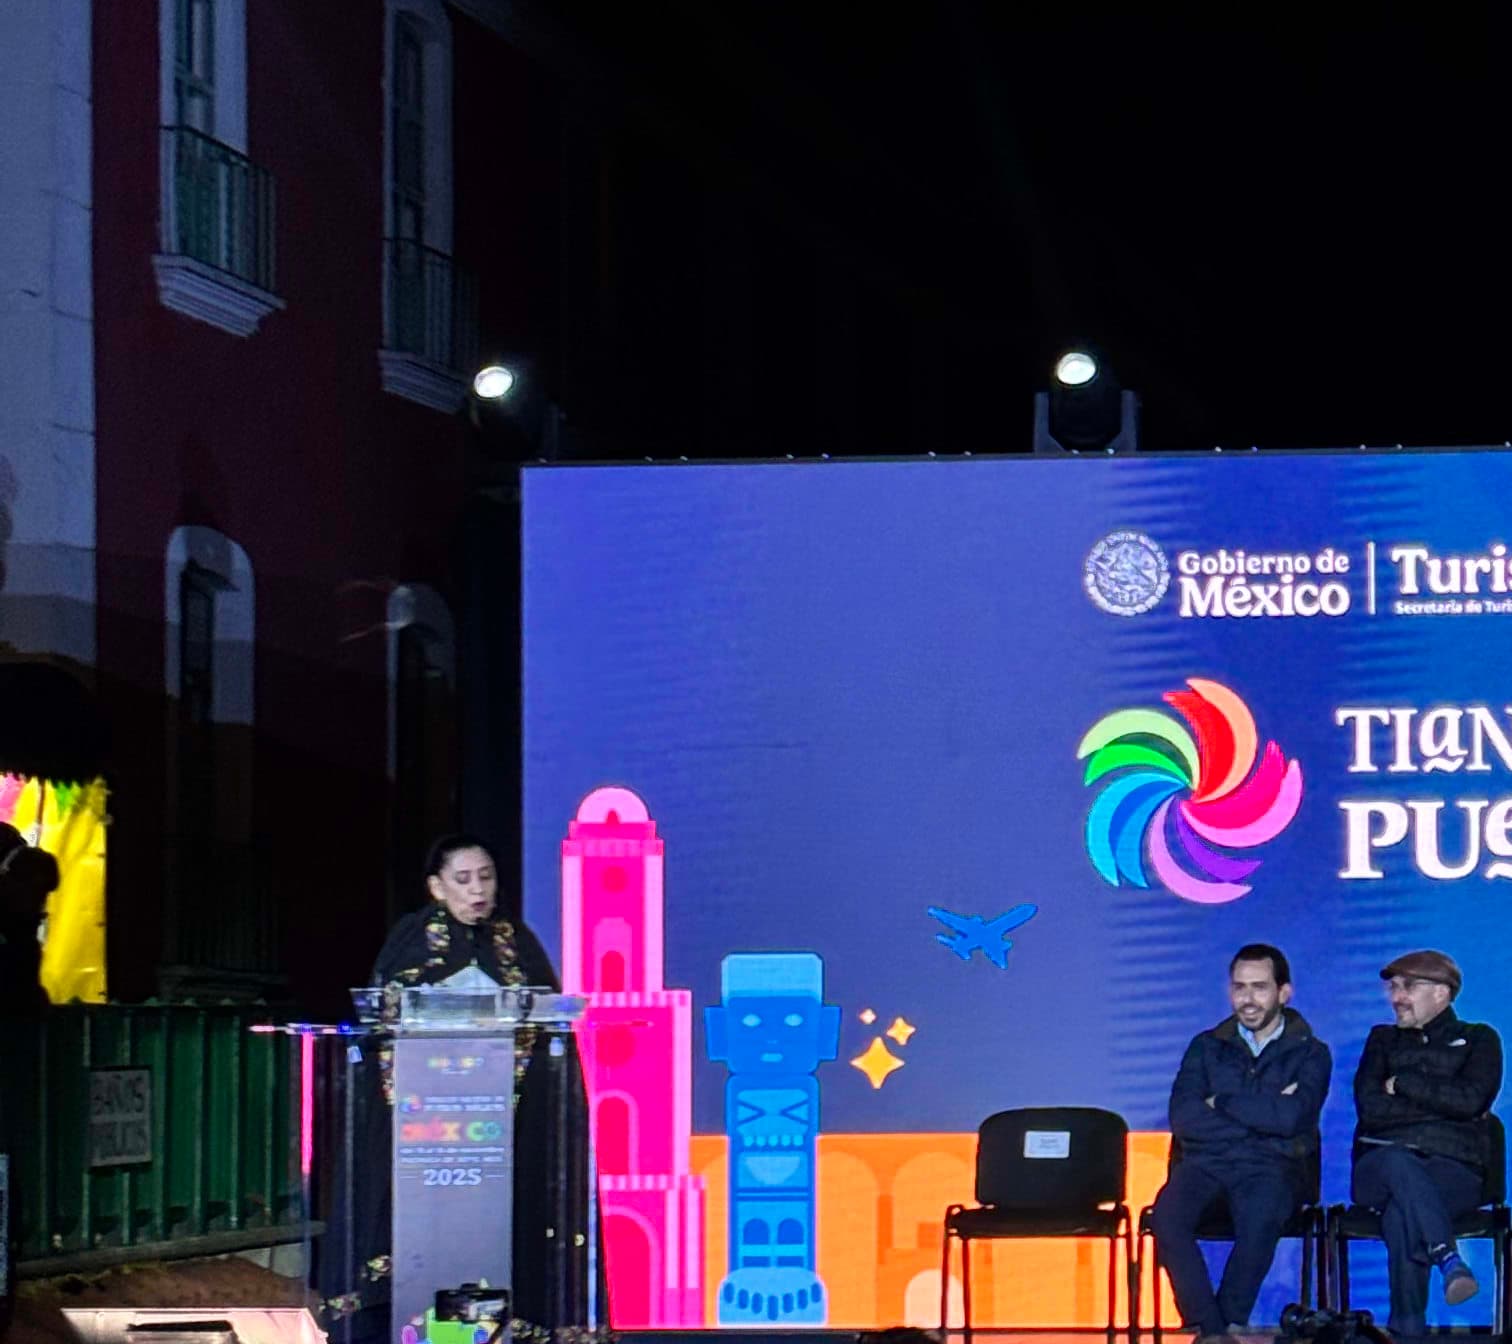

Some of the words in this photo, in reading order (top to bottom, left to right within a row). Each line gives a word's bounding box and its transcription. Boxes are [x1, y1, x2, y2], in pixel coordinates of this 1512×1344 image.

[1178, 549, 1311, 575] Gobierno
[1315, 548, 1350, 574] de
[1178, 575, 1350, 618] México
[423, 1168, 482, 1186] 2025
